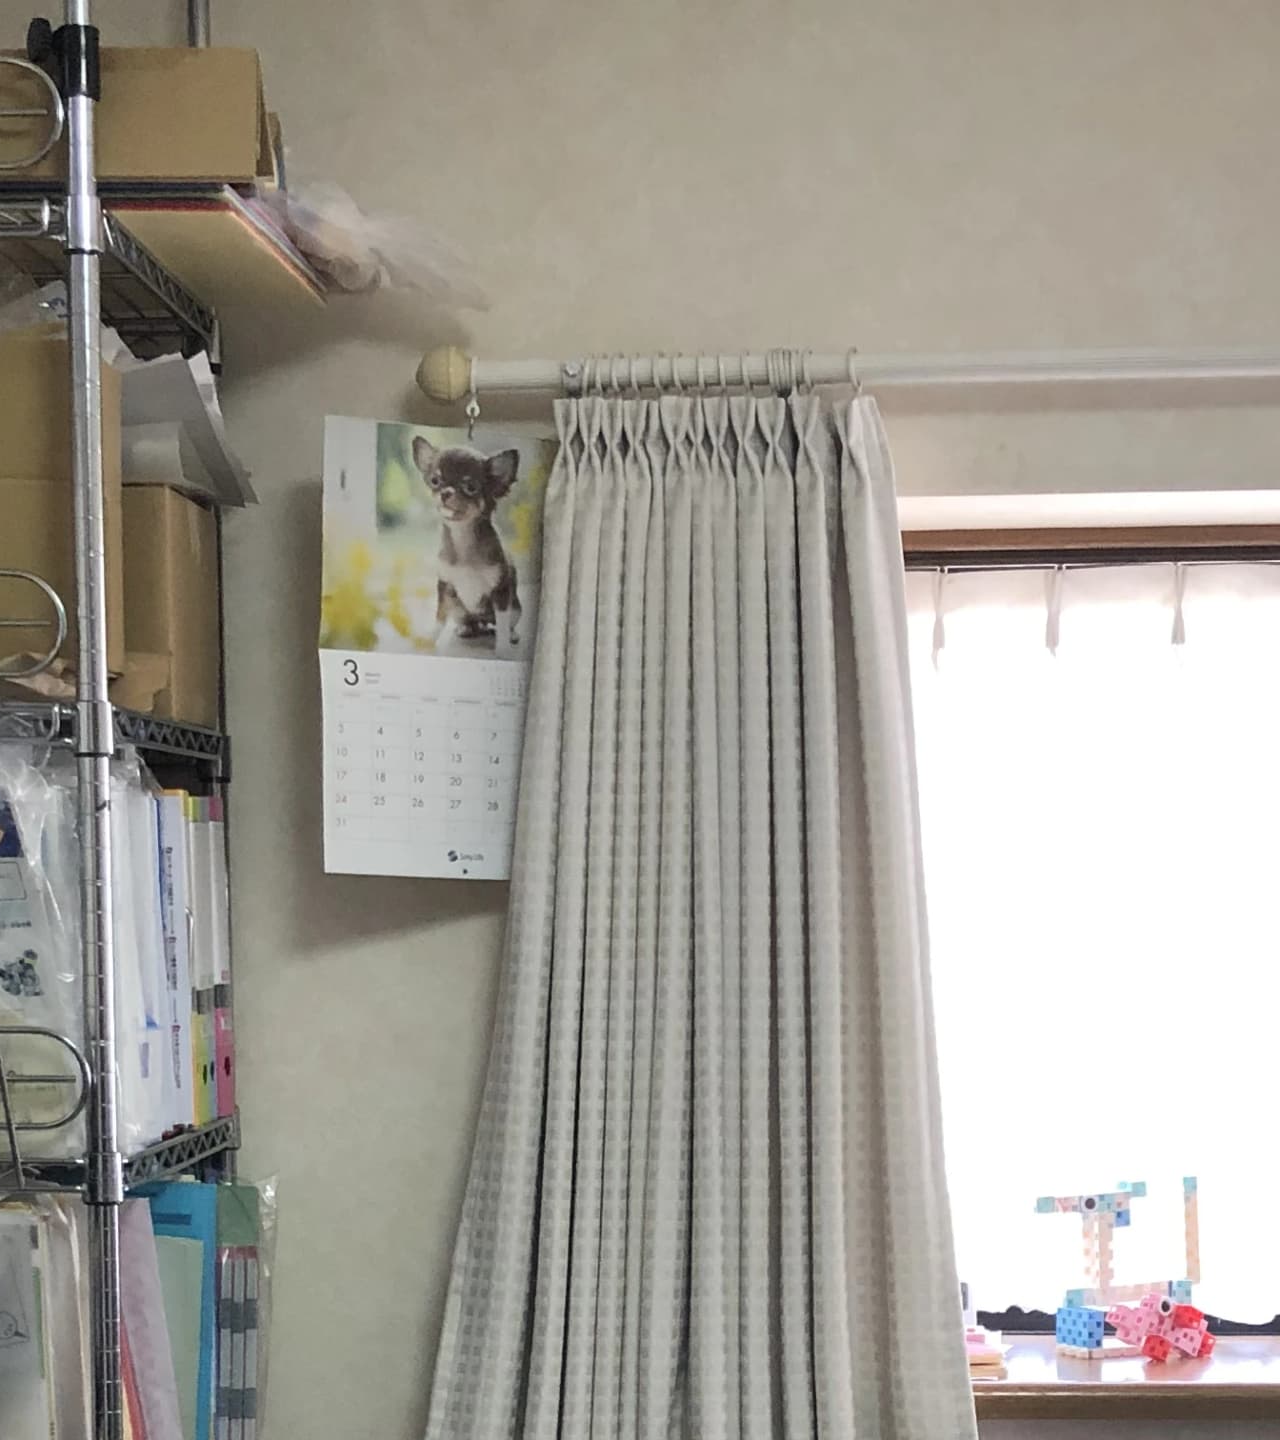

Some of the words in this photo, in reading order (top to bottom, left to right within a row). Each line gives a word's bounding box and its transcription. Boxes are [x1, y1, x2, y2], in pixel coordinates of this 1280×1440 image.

[343, 659, 359, 686] 3
[377, 726, 384, 736] 4
[376, 749, 385, 759] 11
[414, 751, 425, 762] 12
[452, 754, 462, 764] 13
[489, 755, 500, 766] 14
[376, 772, 386, 783] 18
[413, 774, 425, 784] 19
[449, 776, 462, 787] 20
[373, 796, 386, 807] 25
[412, 798, 424, 808] 26
[450, 800, 462, 810] 27
[487, 801, 499, 812] 28
